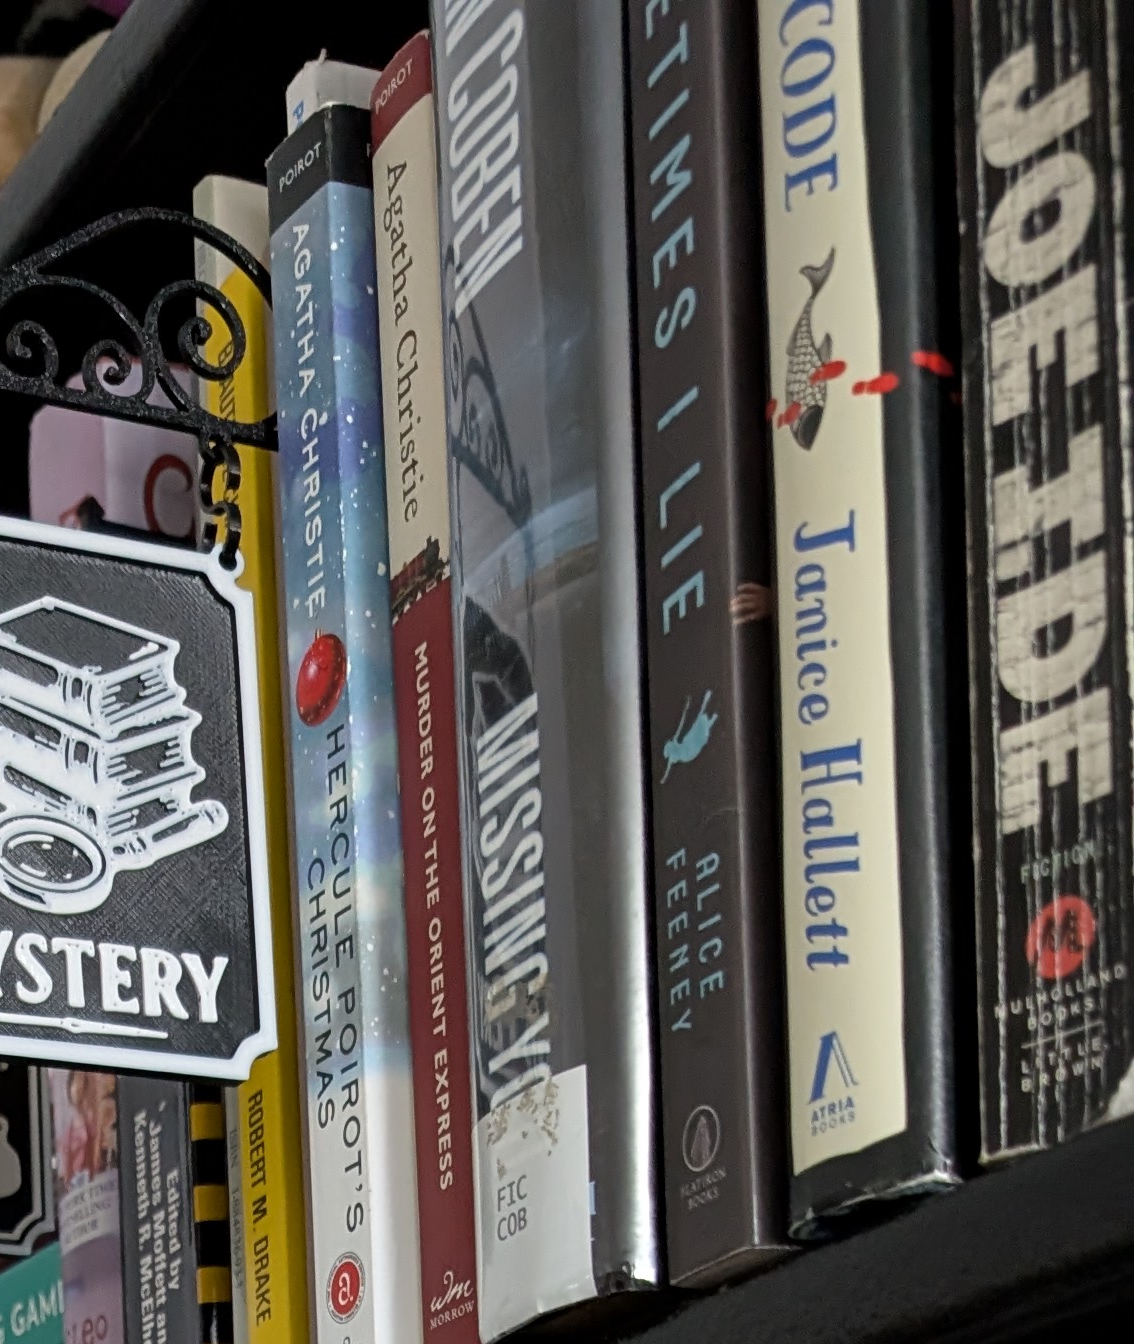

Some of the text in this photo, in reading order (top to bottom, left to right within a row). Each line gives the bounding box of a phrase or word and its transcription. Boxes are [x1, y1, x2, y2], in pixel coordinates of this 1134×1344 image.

[374, 58, 413, 115] POIROT
[778, 0, 839, 212] CODE
[279, 141, 322, 193] POIROT
[448, 8, 523, 319] COBEN
[979, 41, 1100, 426] JOE
[383, 160, 420, 524] Agatha Christie
[291, 223, 328, 619] AGATHA CHRISTIE
[657, 386, 704, 635] I LIE
[792, 509, 863, 972] Janice Hallett
[325, 725, 352, 970] HERCULE
[414, 641, 453, 1191] MURDER ON THE ORIENT EXPRESS
[476, 692, 549, 1022] MISSING
[306, 856, 335, 1129] CHRISTMAS
[665, 846, 692, 1034] FEENEY
[693, 850, 726, 1001] ALICE
[994, 962, 1127, 1019] MULHOLLAND
[1021, 1056, 1102, 1093] BROWN
[1027, 997, 1094, 1031] BOOKS
[134, 1110, 147, 1219] Kenneth
[149, 1120, 161, 1206] James
[338, 988, 364, 1233] POIROT'S
[810, 1096, 855, 1124] ATRIA
[811, 1111, 855, 1136] BOOKS
[153, 1210, 167, 1306] Moffett
[167, 1168, 181, 1290] Edited by
[247, 1089, 272, 1327] ROBERT DRAKE
[496, 1174, 527, 1212] FIC
[496, 1207, 528, 1242] COB
[430, 1301, 474, 1330] MORROW
